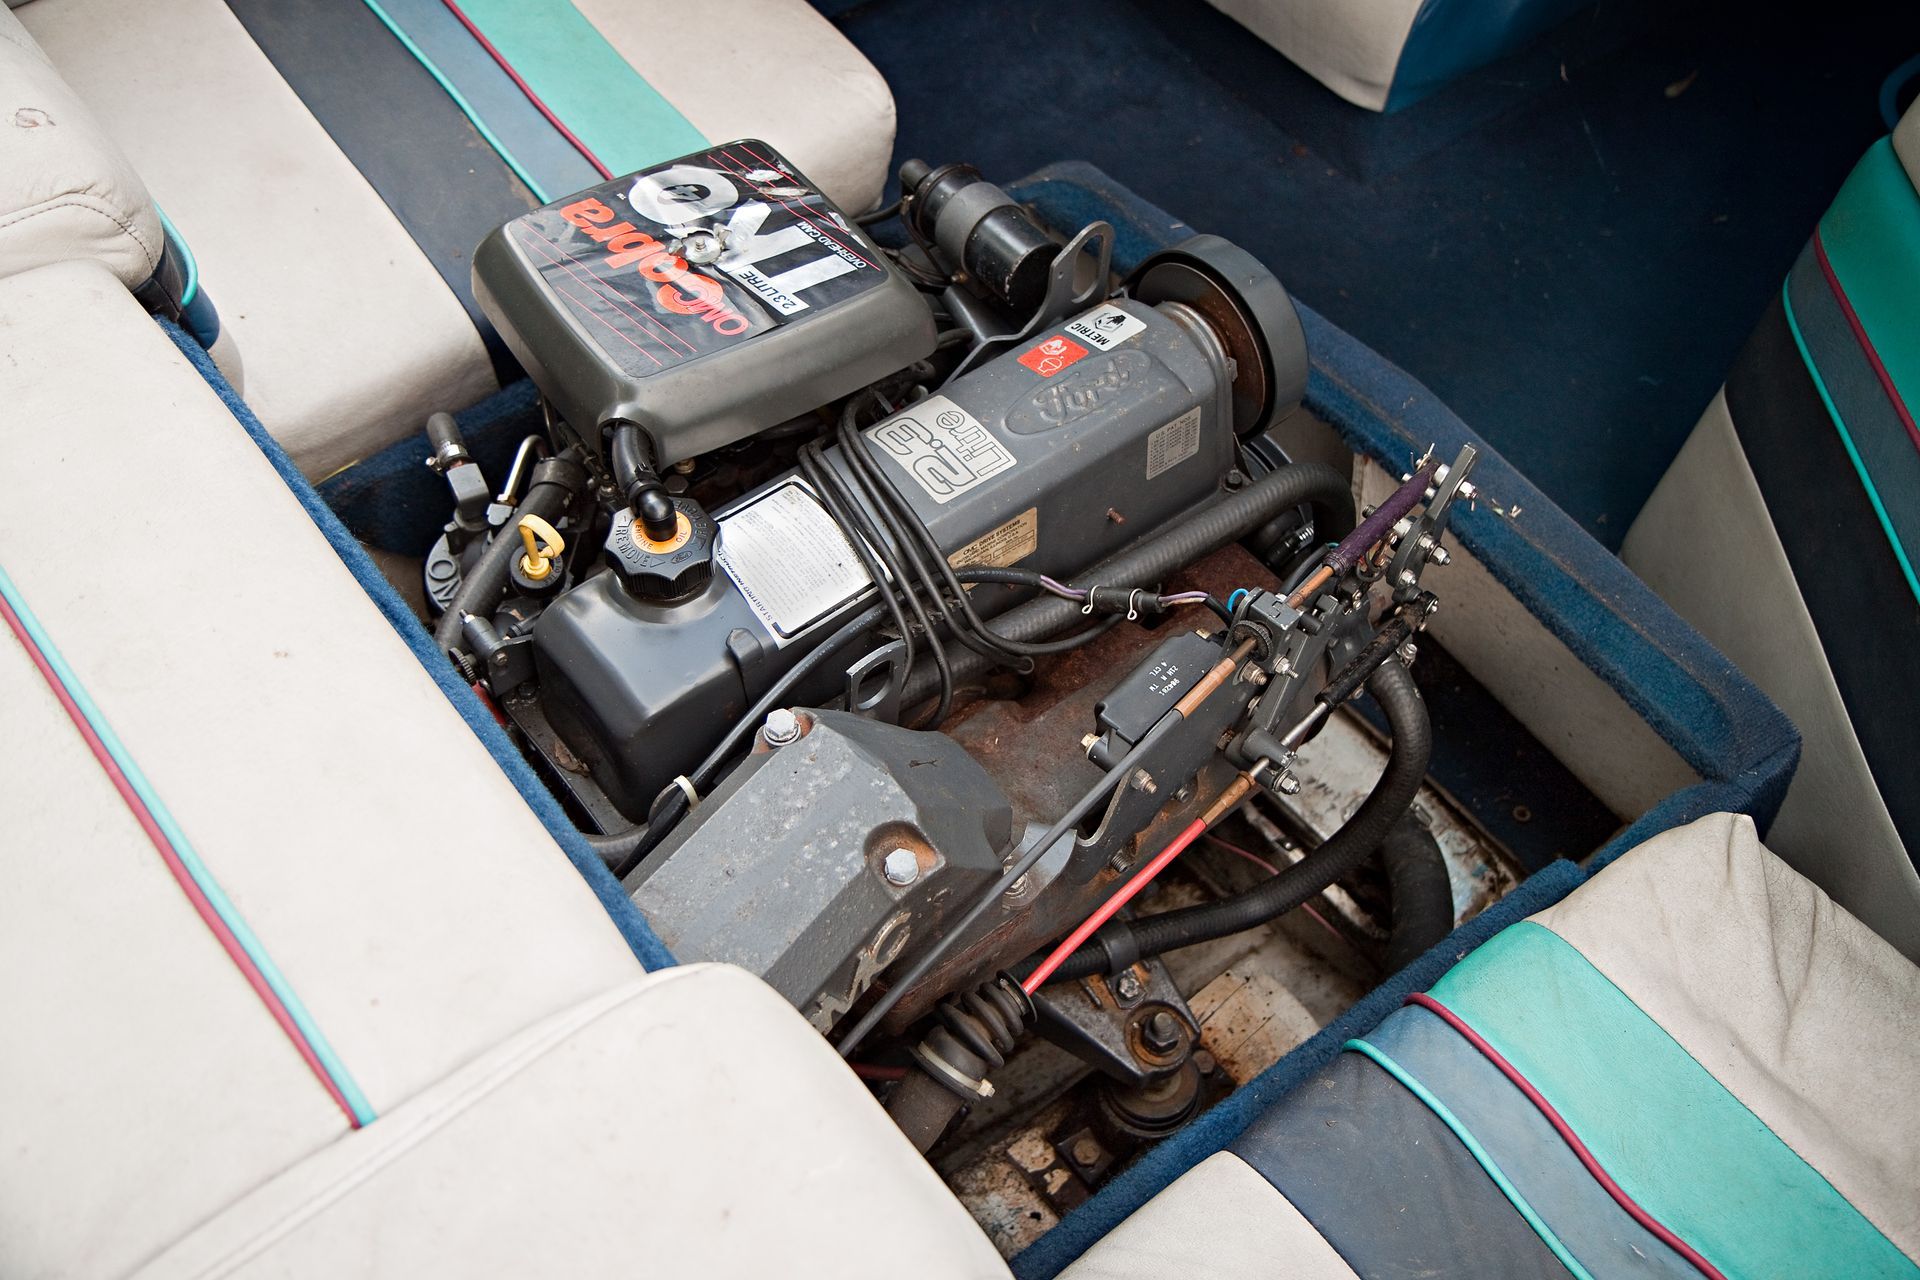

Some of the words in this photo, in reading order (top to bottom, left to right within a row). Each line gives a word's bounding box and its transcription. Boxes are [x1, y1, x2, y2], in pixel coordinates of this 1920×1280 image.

[796, 221, 821, 240] CAM
[560, 197, 724, 316] Cobra
[818, 235, 867, 269] OVERHEAD
[738, 270, 781, 295] LITRE
[673, 284, 749, 336] OMC
[773, 291, 797, 310] 2.3
[1070, 323, 1111, 346] METRIC
[1033, 358, 1130, 422] Ford
[875, 417, 978, 494] 2.3
[936, 410, 1011, 477] Litre
[615, 528, 650, 567] REMOVE
[635, 524, 654, 550] ENGINE
[676, 531, 688, 543] OIL
[979, 535, 995, 546] DRIVE
[995, 519, 1021, 537] SYSTEMS
[743, 586, 773, 621] STARTING
